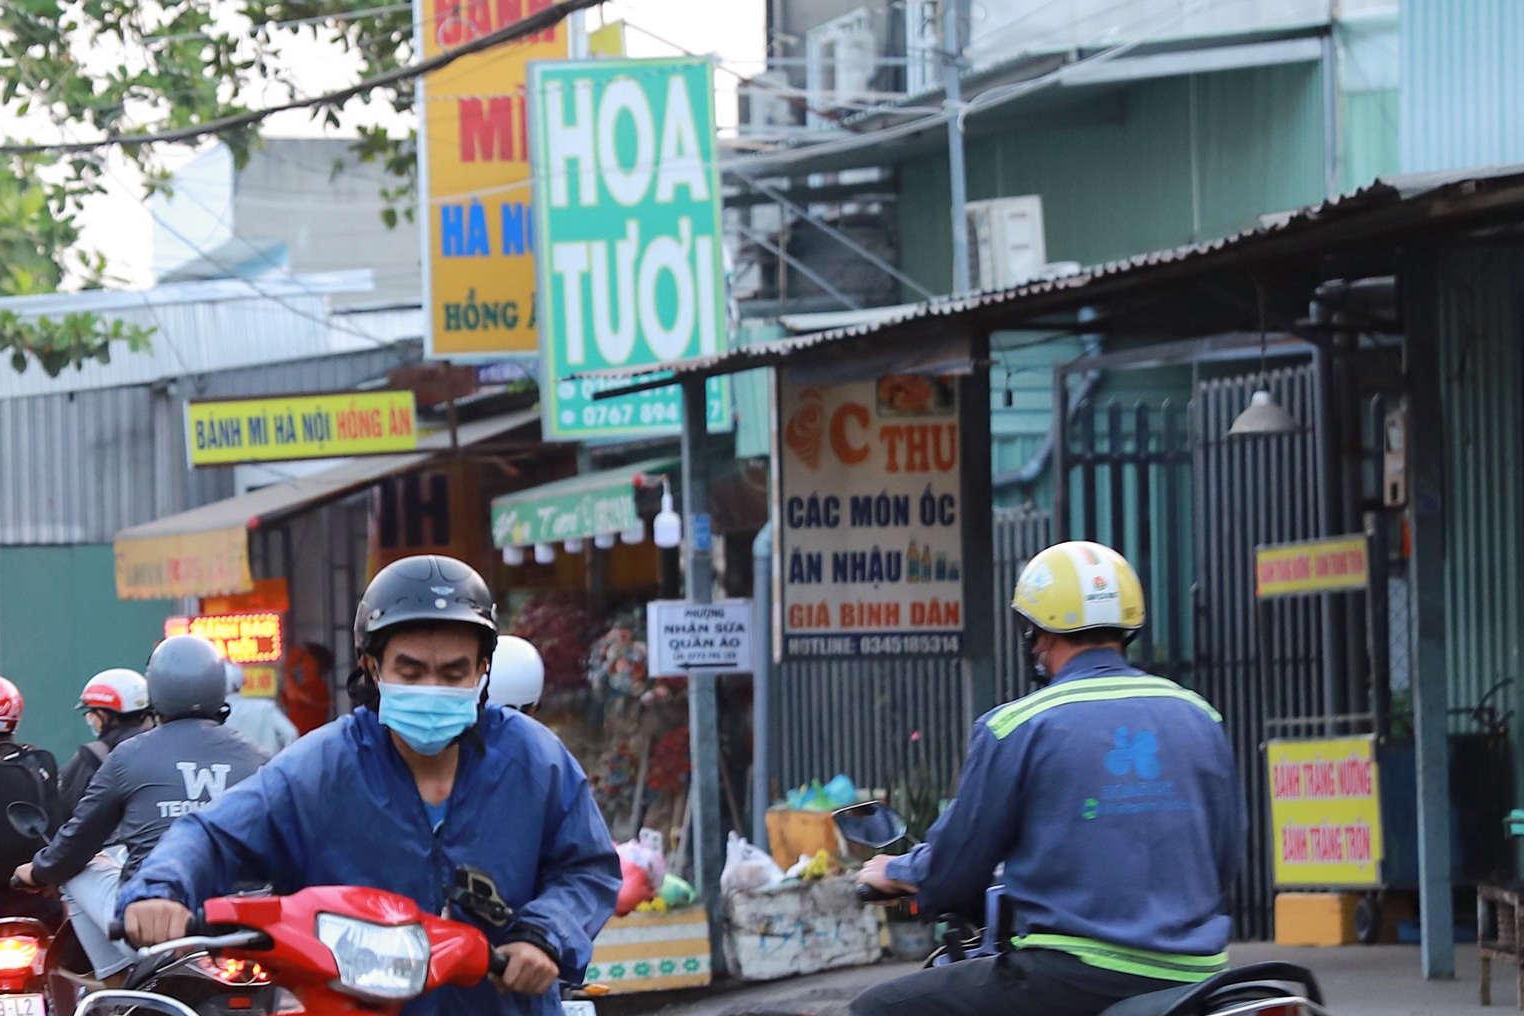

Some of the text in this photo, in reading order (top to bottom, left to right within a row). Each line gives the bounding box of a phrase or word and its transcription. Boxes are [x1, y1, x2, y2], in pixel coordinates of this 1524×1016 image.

[545, 75, 710, 207] HOA
[441, 197, 490, 257] HÀ
[551, 216, 717, 366] TƯƠI
[195, 411, 242, 451] BÁNH
[247, 406, 270, 446] MÌ
[274, 410, 298, 445] HÀ
[879, 422, 957, 474] THU
[787, 482, 956, 529] CÁC MÓN ỐC
[788, 543, 902, 590] ĂN NHẬU
[788, 596, 960, 629] GIÁ BÌNH DÂN
[175, 761, 232, 802] W
